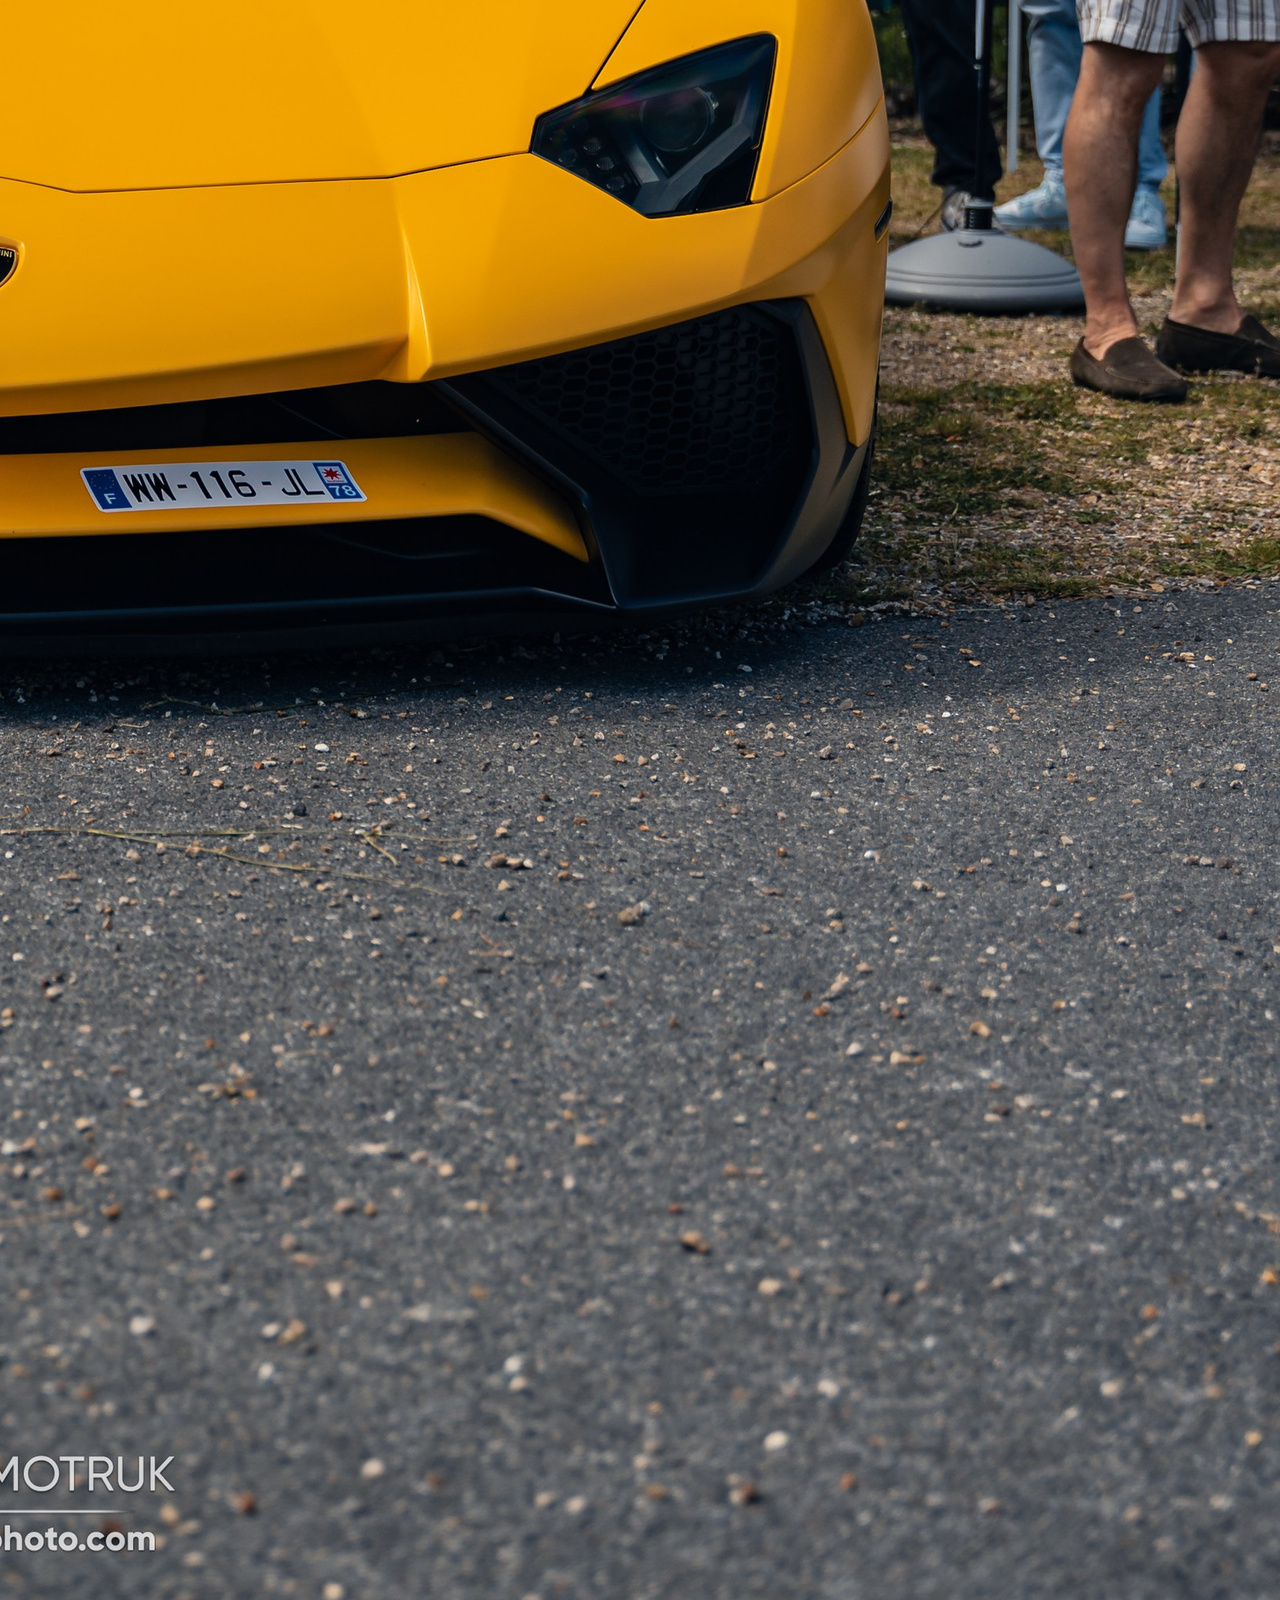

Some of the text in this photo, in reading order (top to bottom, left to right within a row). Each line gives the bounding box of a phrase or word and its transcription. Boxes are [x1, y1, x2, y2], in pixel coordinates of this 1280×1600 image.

[122, 467, 326, 504] WW-116-JL
[328, 485, 357, 497] 78
[104, 492, 117, 505] F
